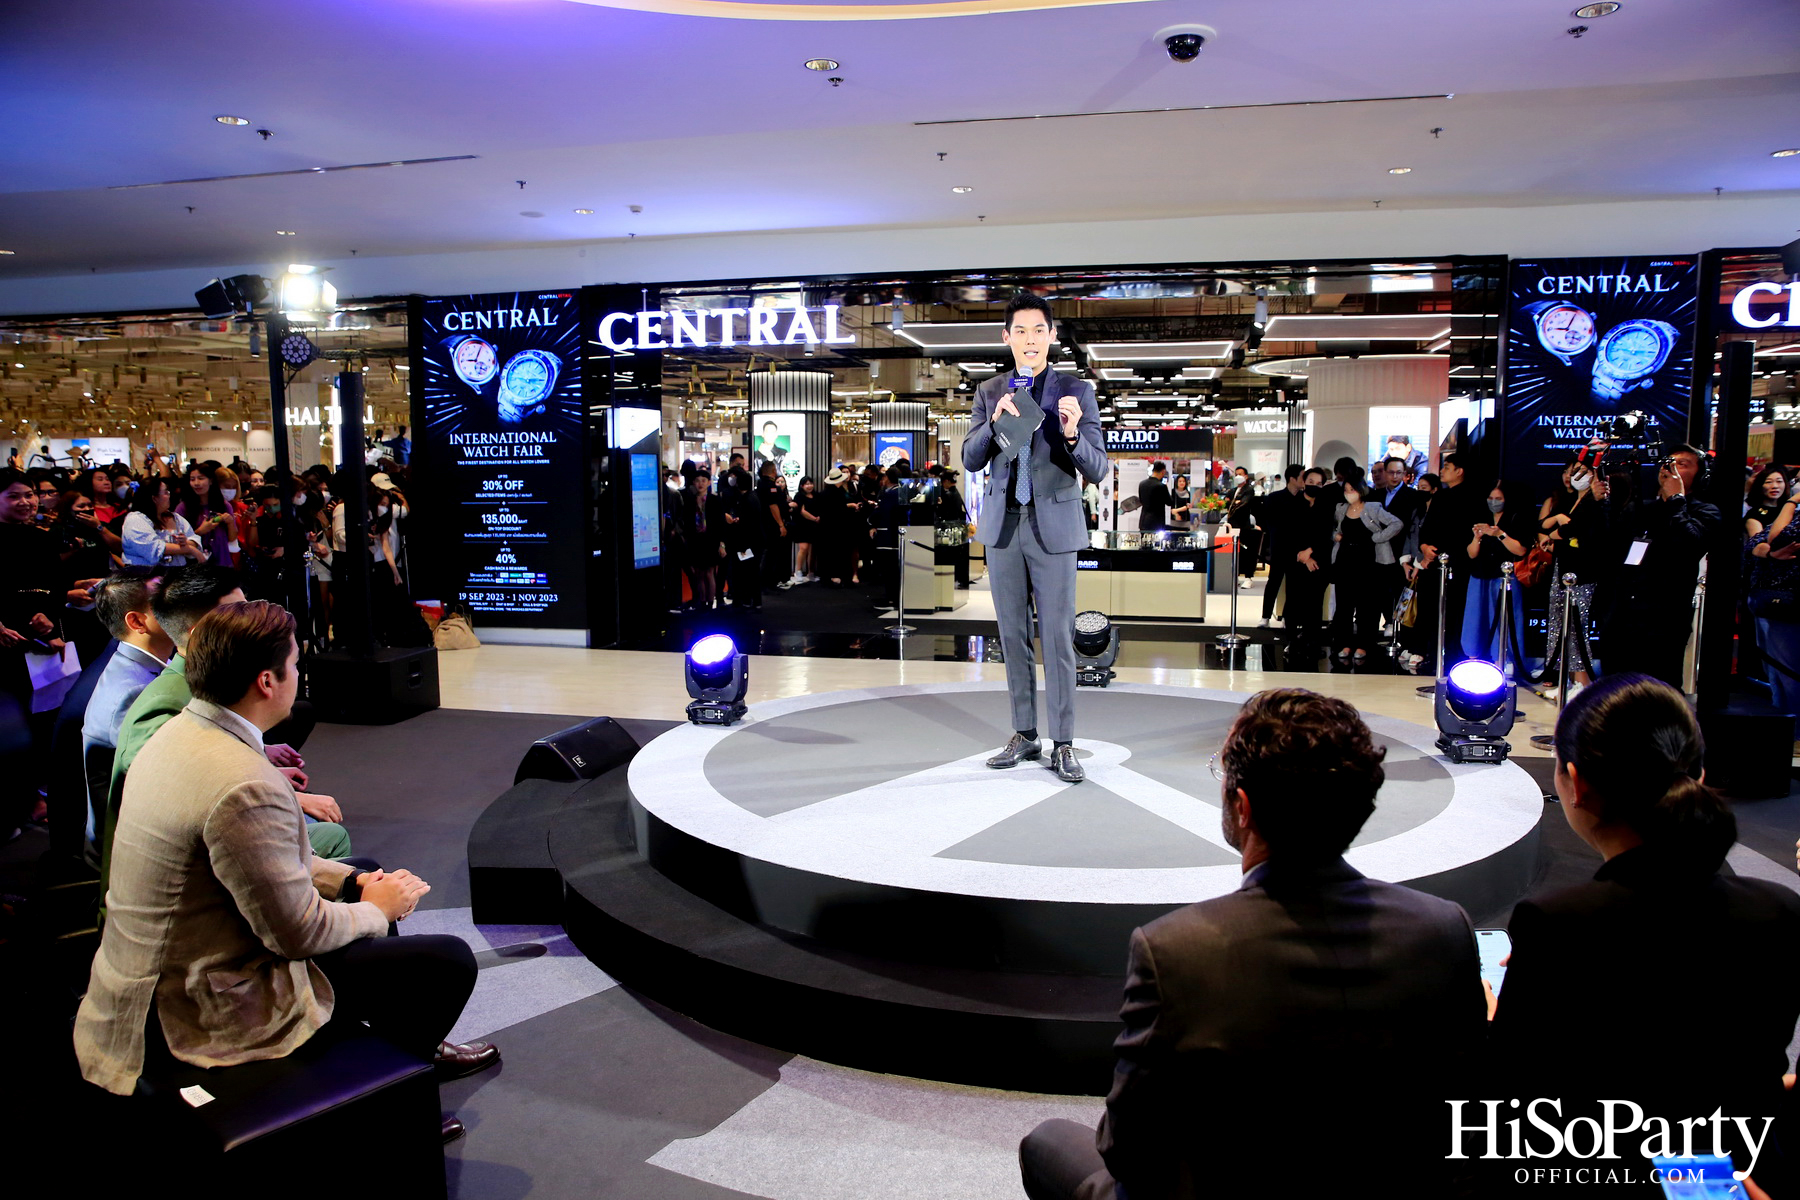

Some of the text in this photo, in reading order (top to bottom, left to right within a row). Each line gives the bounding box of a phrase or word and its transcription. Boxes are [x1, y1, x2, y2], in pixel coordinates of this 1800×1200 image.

[1537, 273, 1670, 294] CENTRAL
[444, 307, 557, 331] CENTRAL
[598, 305, 856, 350] CENTRAL
[1243, 420, 1288, 433] WATCH
[1553, 428, 1606, 438] WATCH
[449, 431, 557, 445] INTERNATIONAL
[1107, 430, 1160, 443] RADO
[463, 444, 544, 457] WATCH FAIR
[482, 480, 524, 491] 30% OFF
[481, 514, 518, 525] 135,000
[495, 553, 517, 564] 40%
[458, 592, 467, 600] 19
[485, 593, 505, 601] 2023
[538, 594, 558, 602] 2023
[1529, 618, 1538, 626] 19
